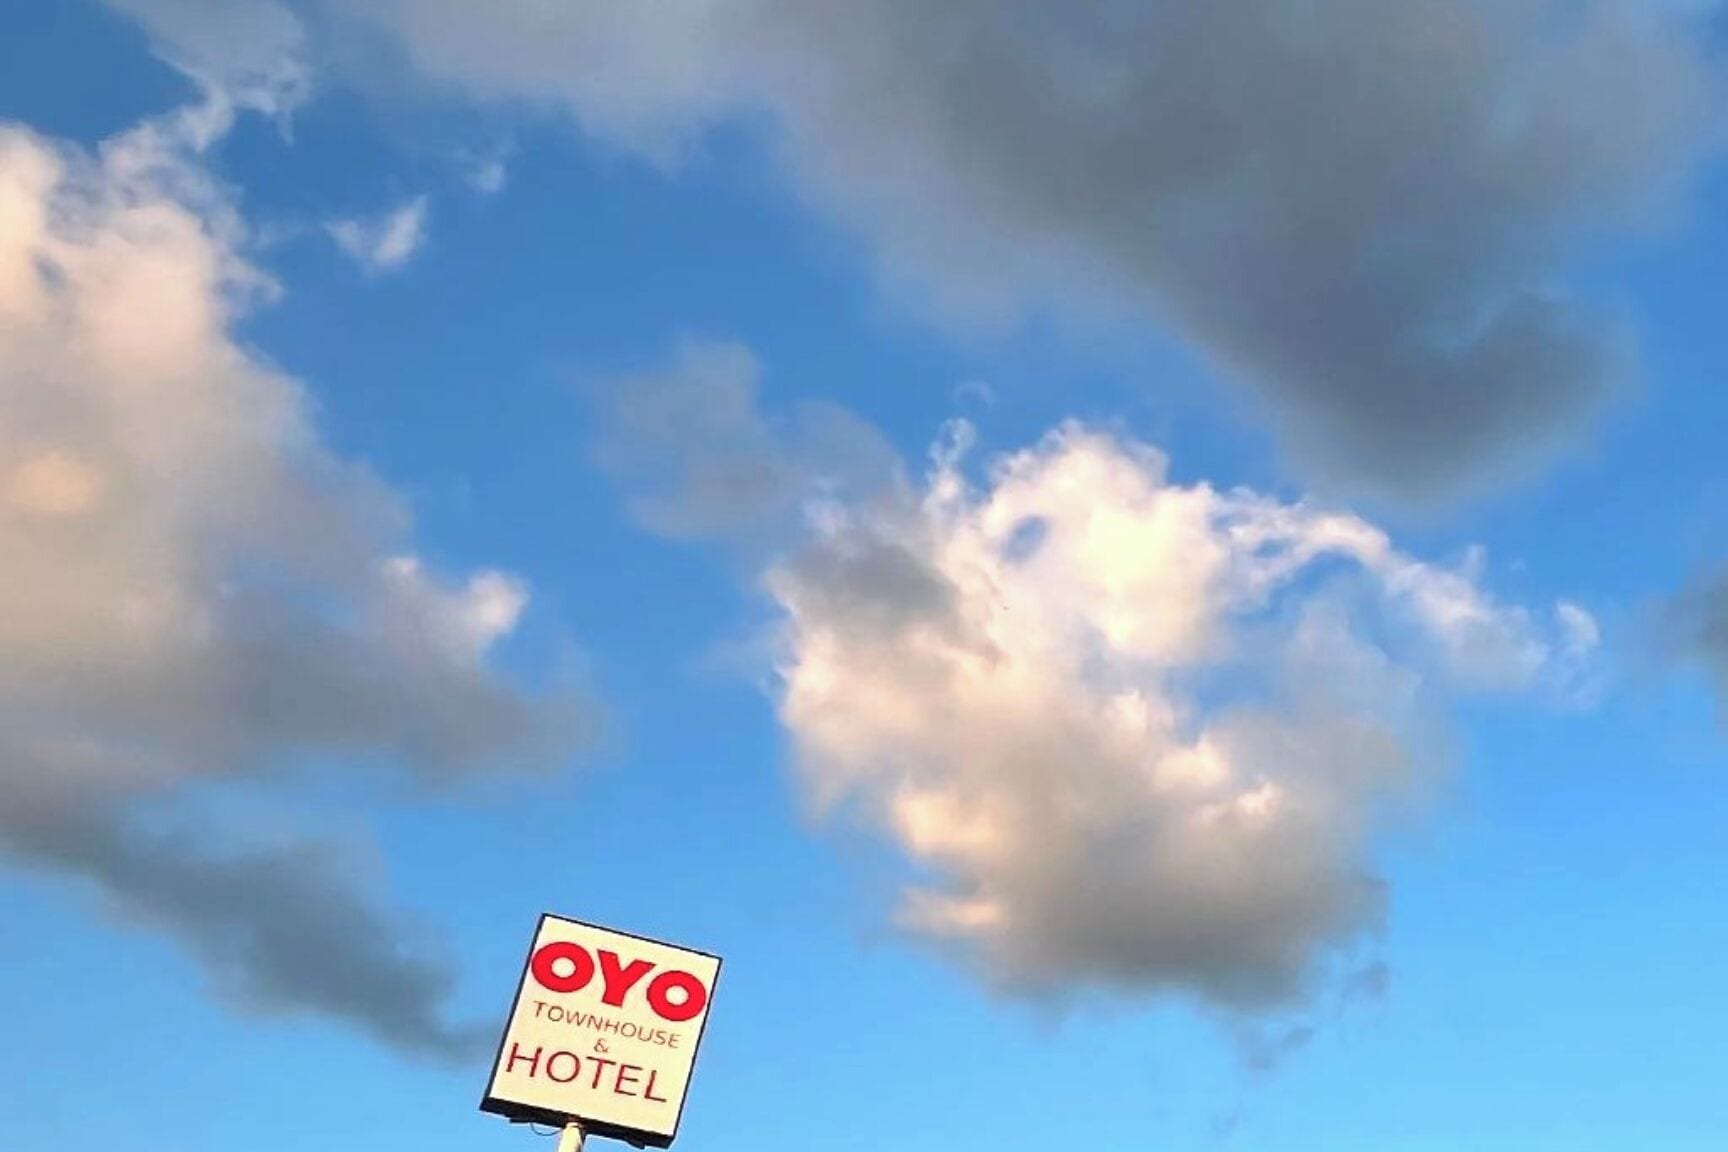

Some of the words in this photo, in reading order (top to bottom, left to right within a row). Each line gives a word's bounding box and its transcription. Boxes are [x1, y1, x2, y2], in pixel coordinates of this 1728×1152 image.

[531, 941, 707, 1022] OYO
[533, 1000, 682, 1049] TOWNHOUSE
[593, 1037, 609, 1054] &
[506, 1042, 668, 1103] HOTEL
